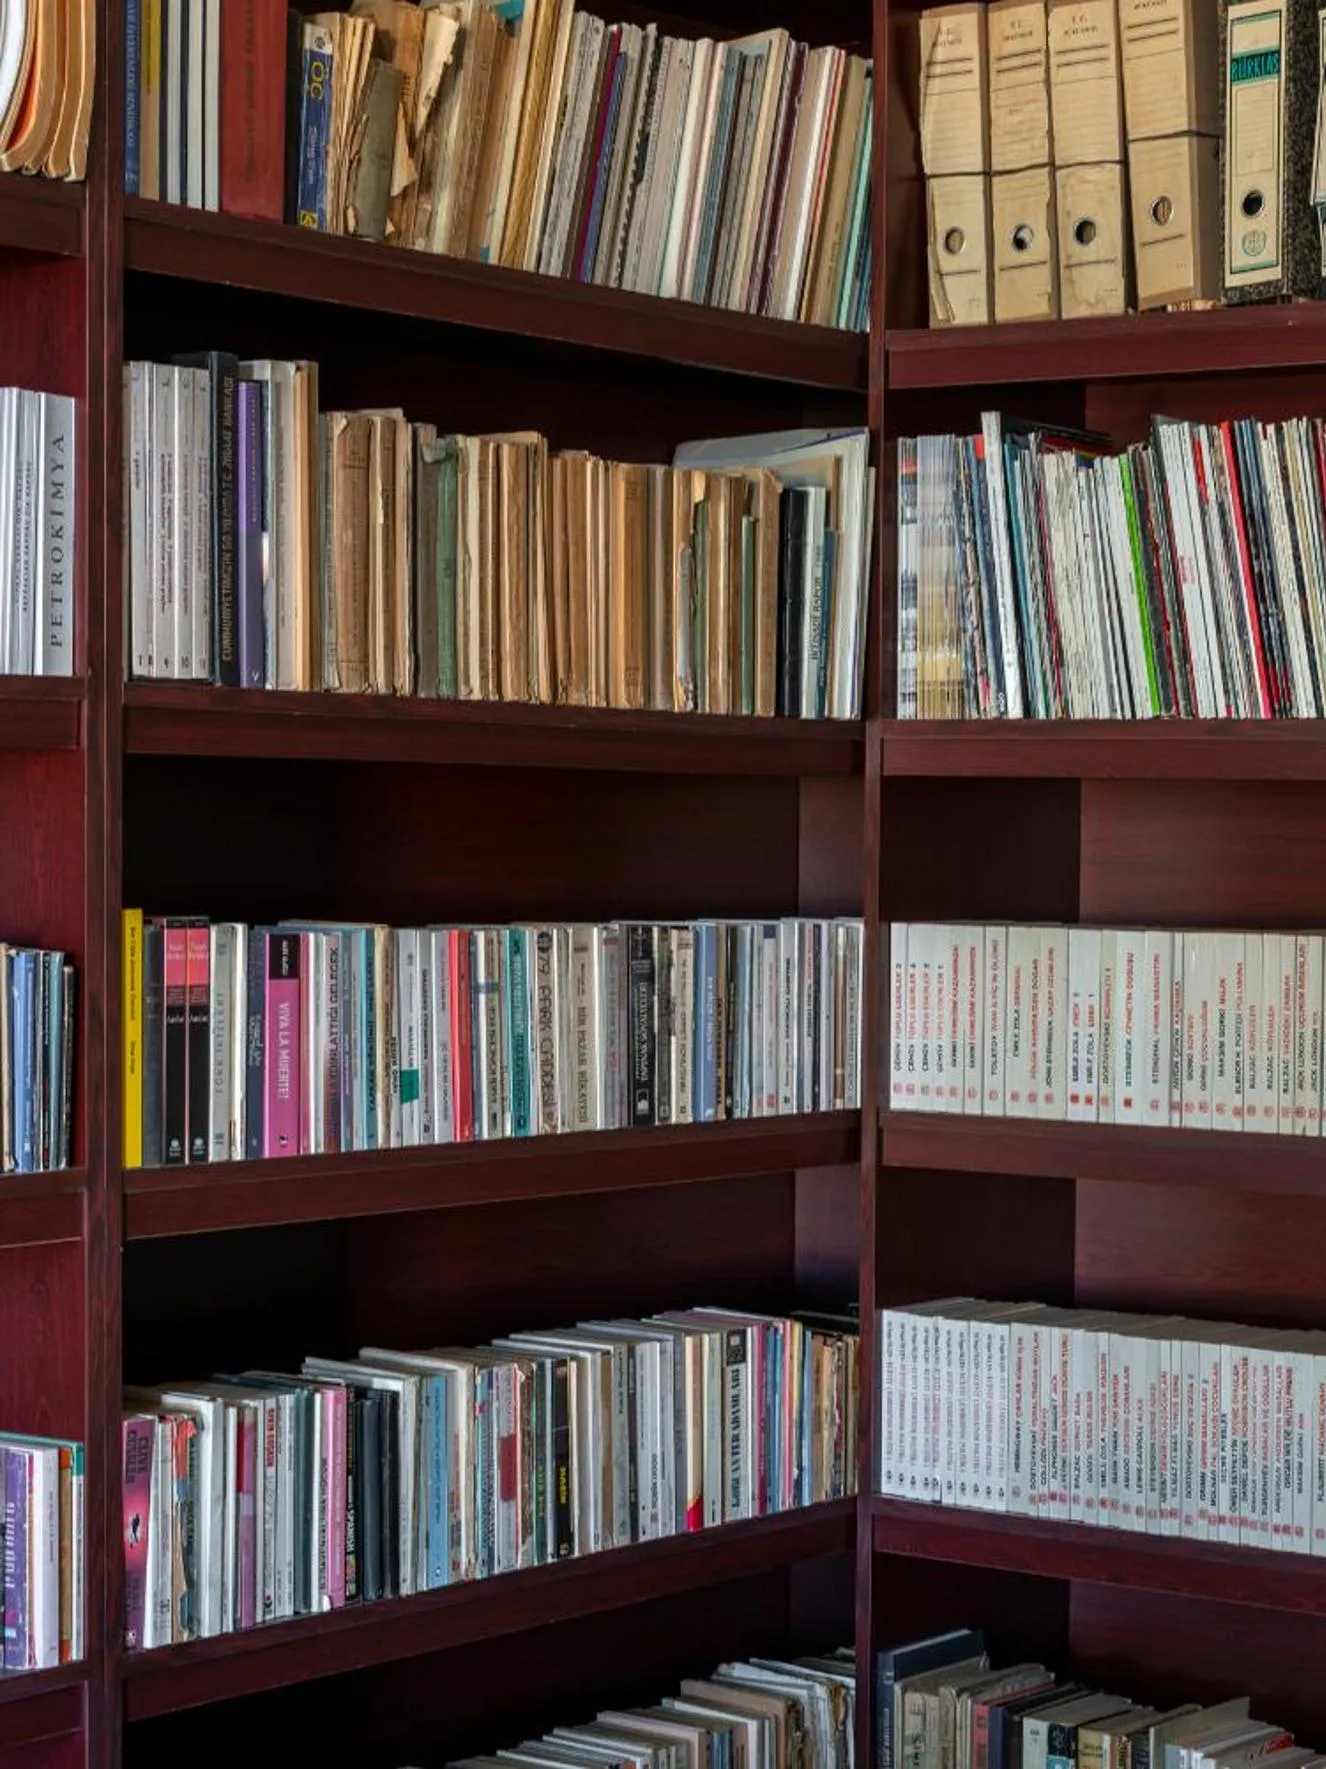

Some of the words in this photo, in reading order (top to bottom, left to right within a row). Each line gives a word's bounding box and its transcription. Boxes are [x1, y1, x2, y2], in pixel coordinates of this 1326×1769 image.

[49, 434, 65, 648] PETROKİMYA
[279, 1002, 290, 1029] VIVA
[279, 1031, 290, 1047] LA
